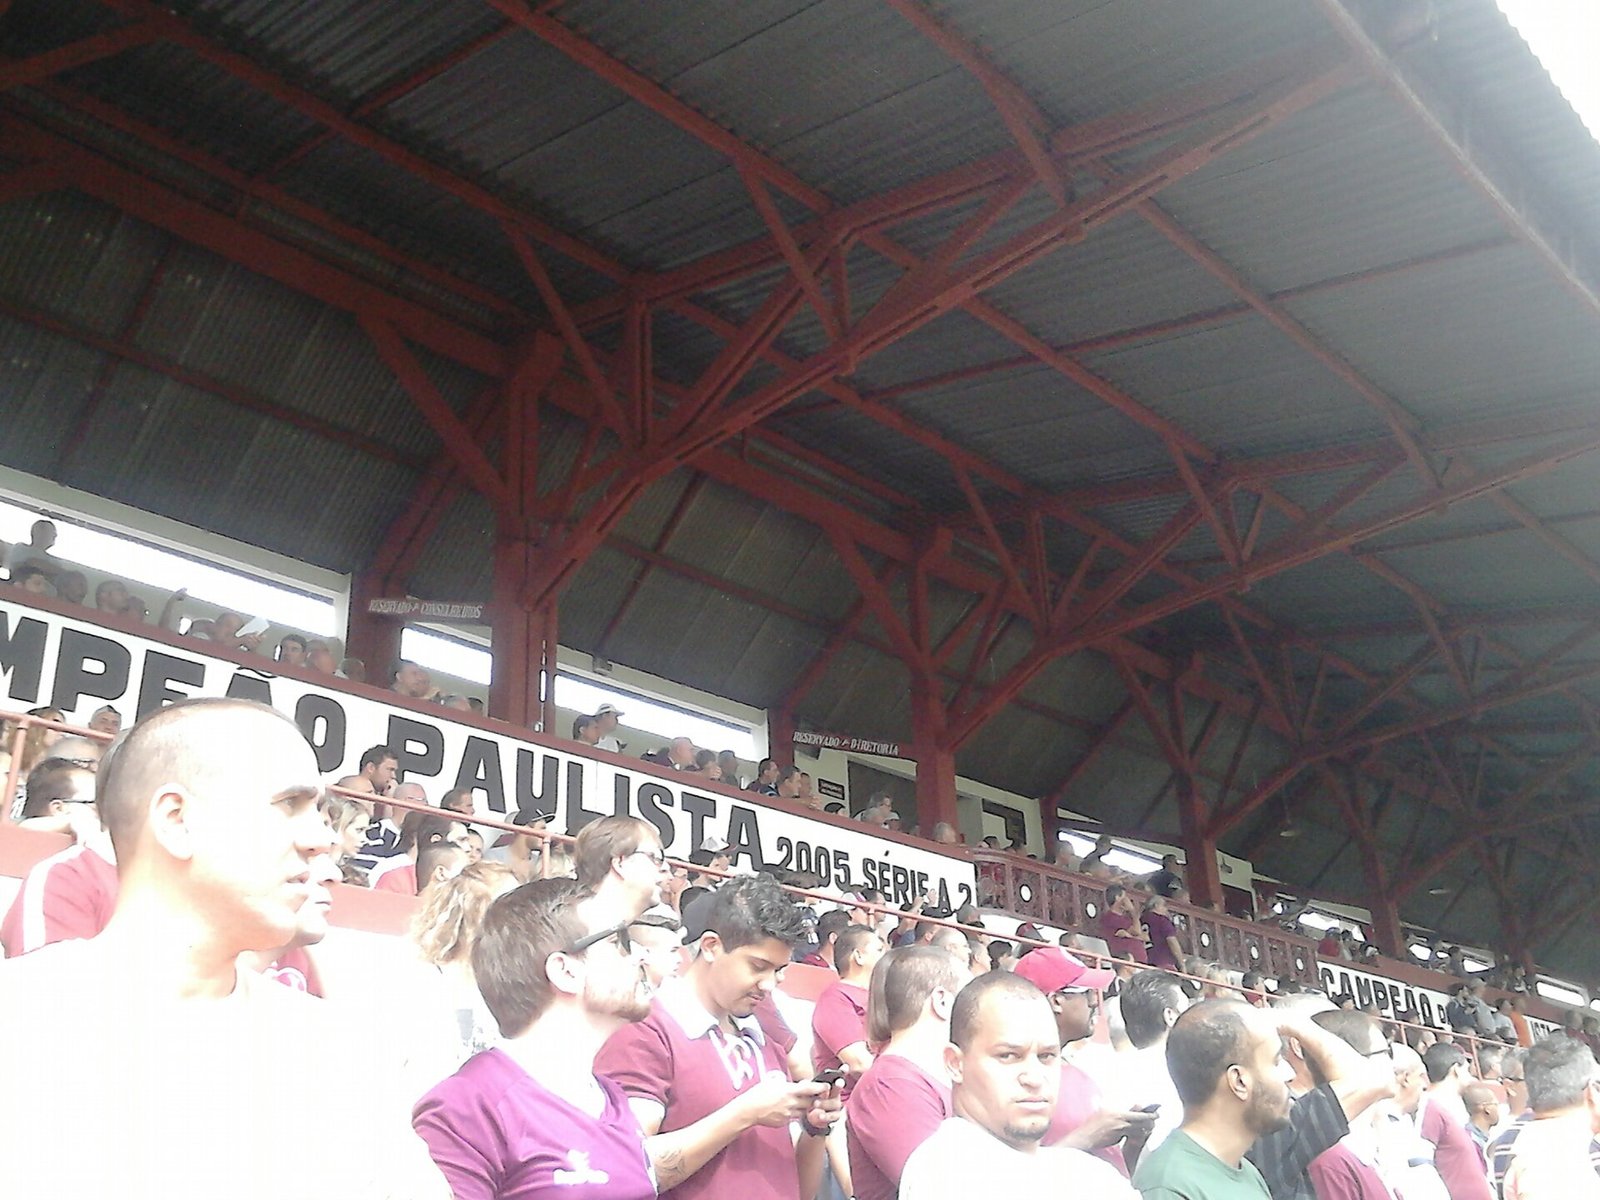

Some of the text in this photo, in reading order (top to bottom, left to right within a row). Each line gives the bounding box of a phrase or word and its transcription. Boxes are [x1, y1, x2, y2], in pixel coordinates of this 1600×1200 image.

[793, 731, 840, 747] RESERVADO
[850, 738, 899, 756] DIRETORIA
[387, 714, 763, 871] PAULISTA
[777, 837, 850, 893] 2005
[862, 850, 928, 905] SÉRIE
[1321, 968, 1434, 1028] CAMPEÃO
